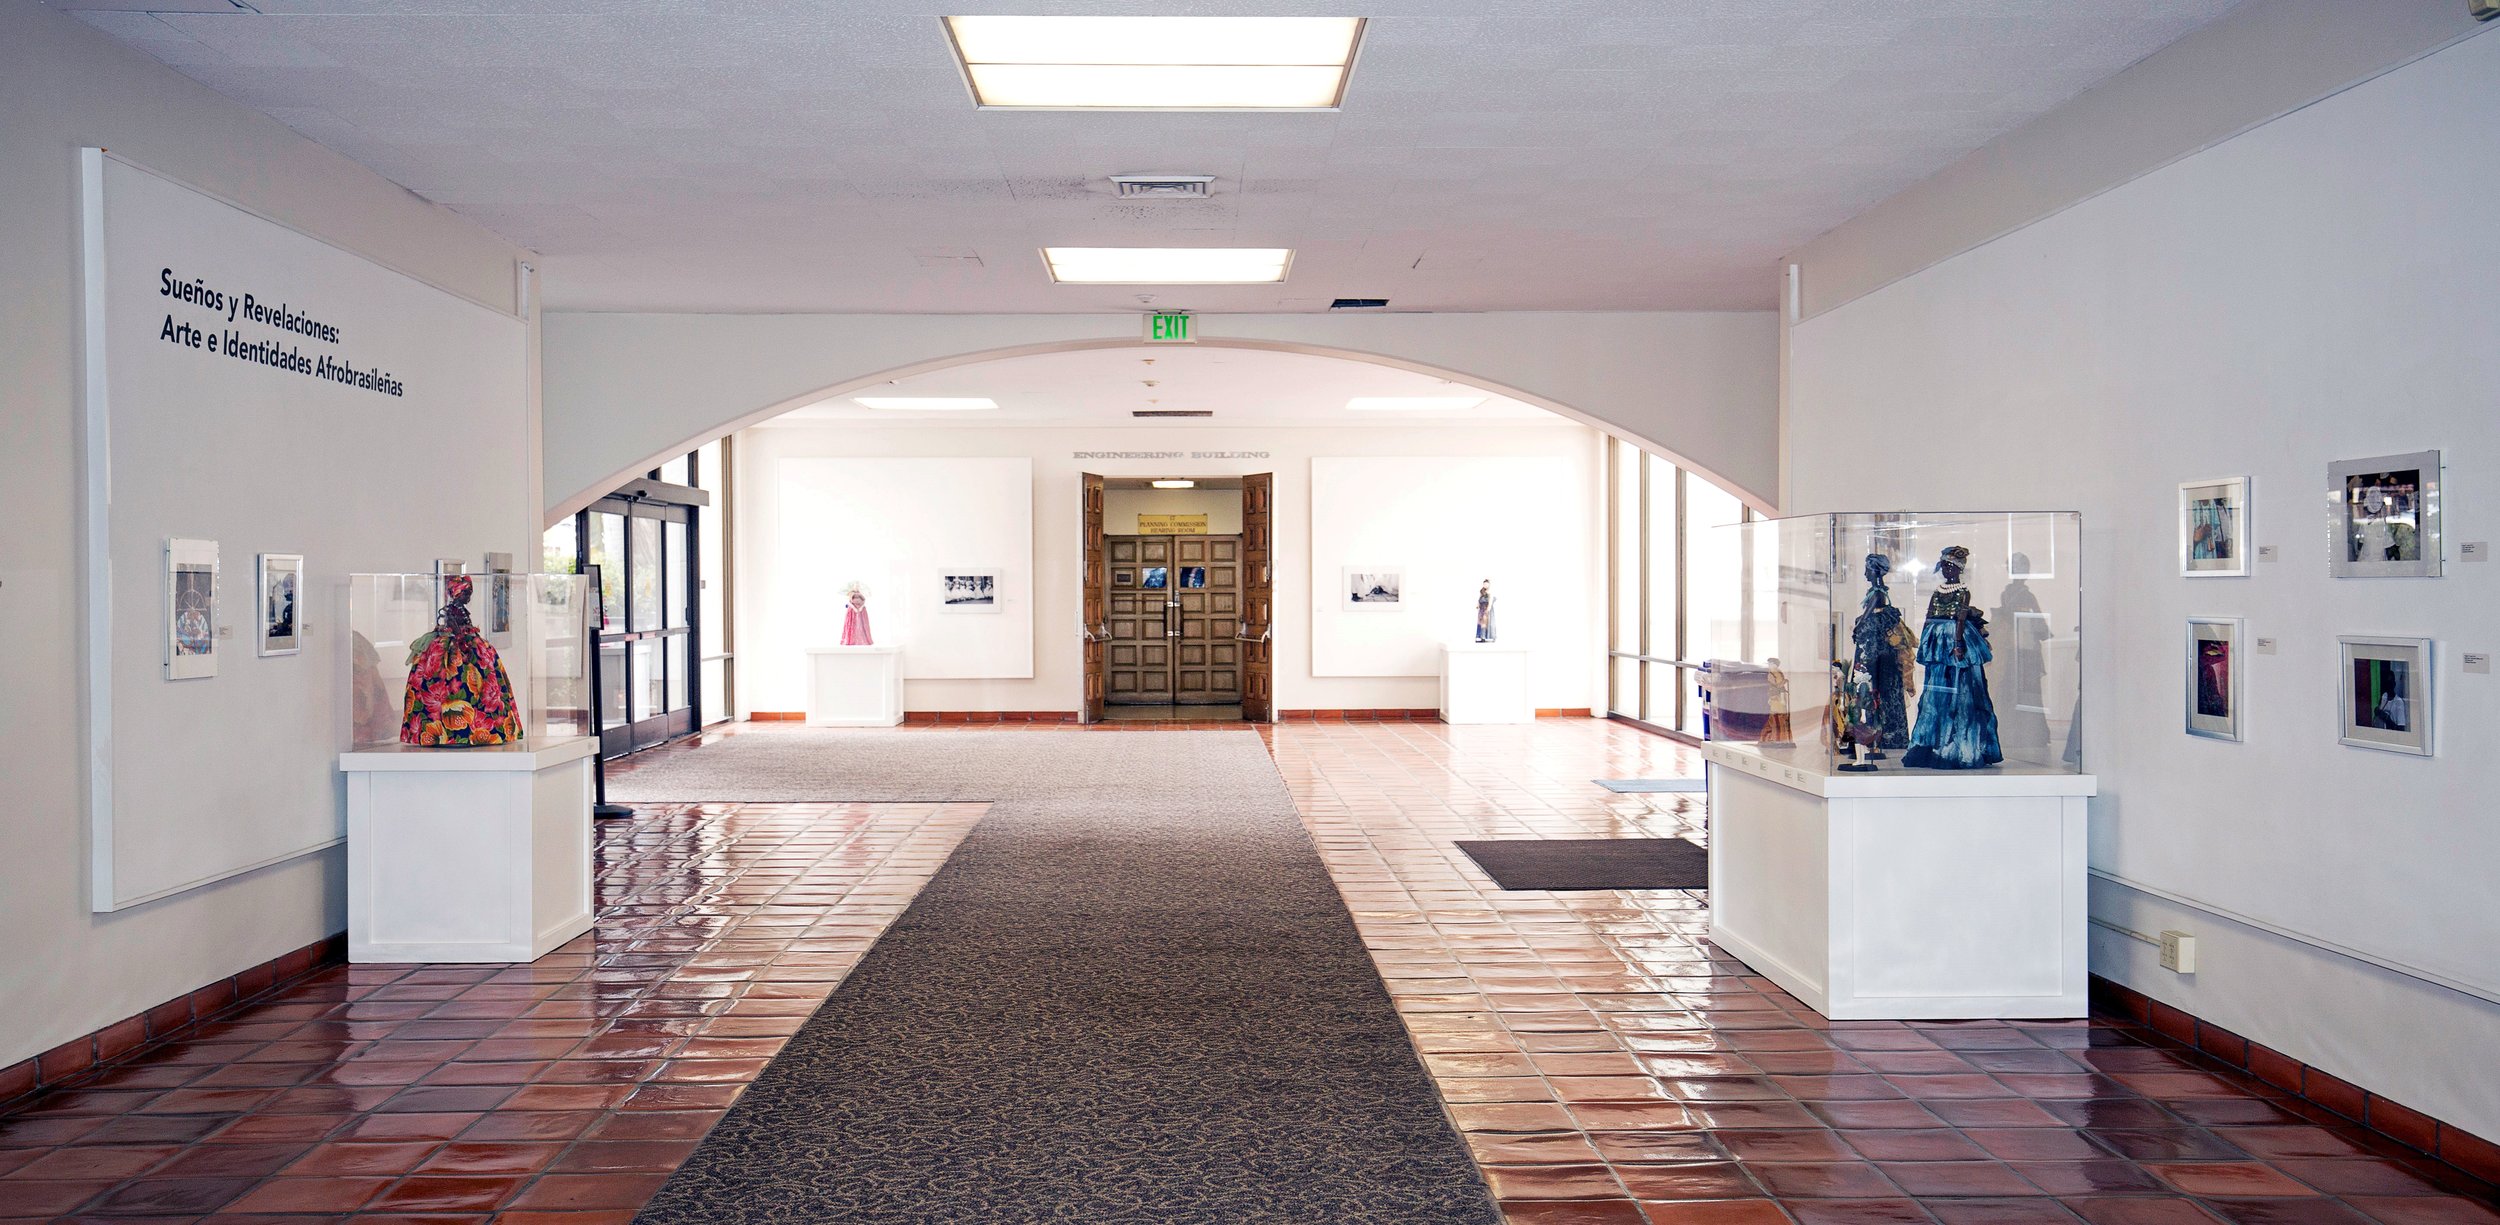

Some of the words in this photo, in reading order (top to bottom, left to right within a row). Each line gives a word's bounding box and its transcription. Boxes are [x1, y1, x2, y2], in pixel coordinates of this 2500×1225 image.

[160, 268, 223, 311] Sueños
[227, 295, 239, 322] y
[243, 293, 340, 344] Revelaciones:
[1152, 315, 1190, 340] EXIT
[160, 314, 202, 349] Arte
[207, 333, 218, 352] e
[223, 329, 312, 376] Identidades
[315, 355, 403, 397] Afrobrasileñas
[1073, 451, 1184, 459] ENGINEERING
[1191, 451, 1270, 459] BUILDING
